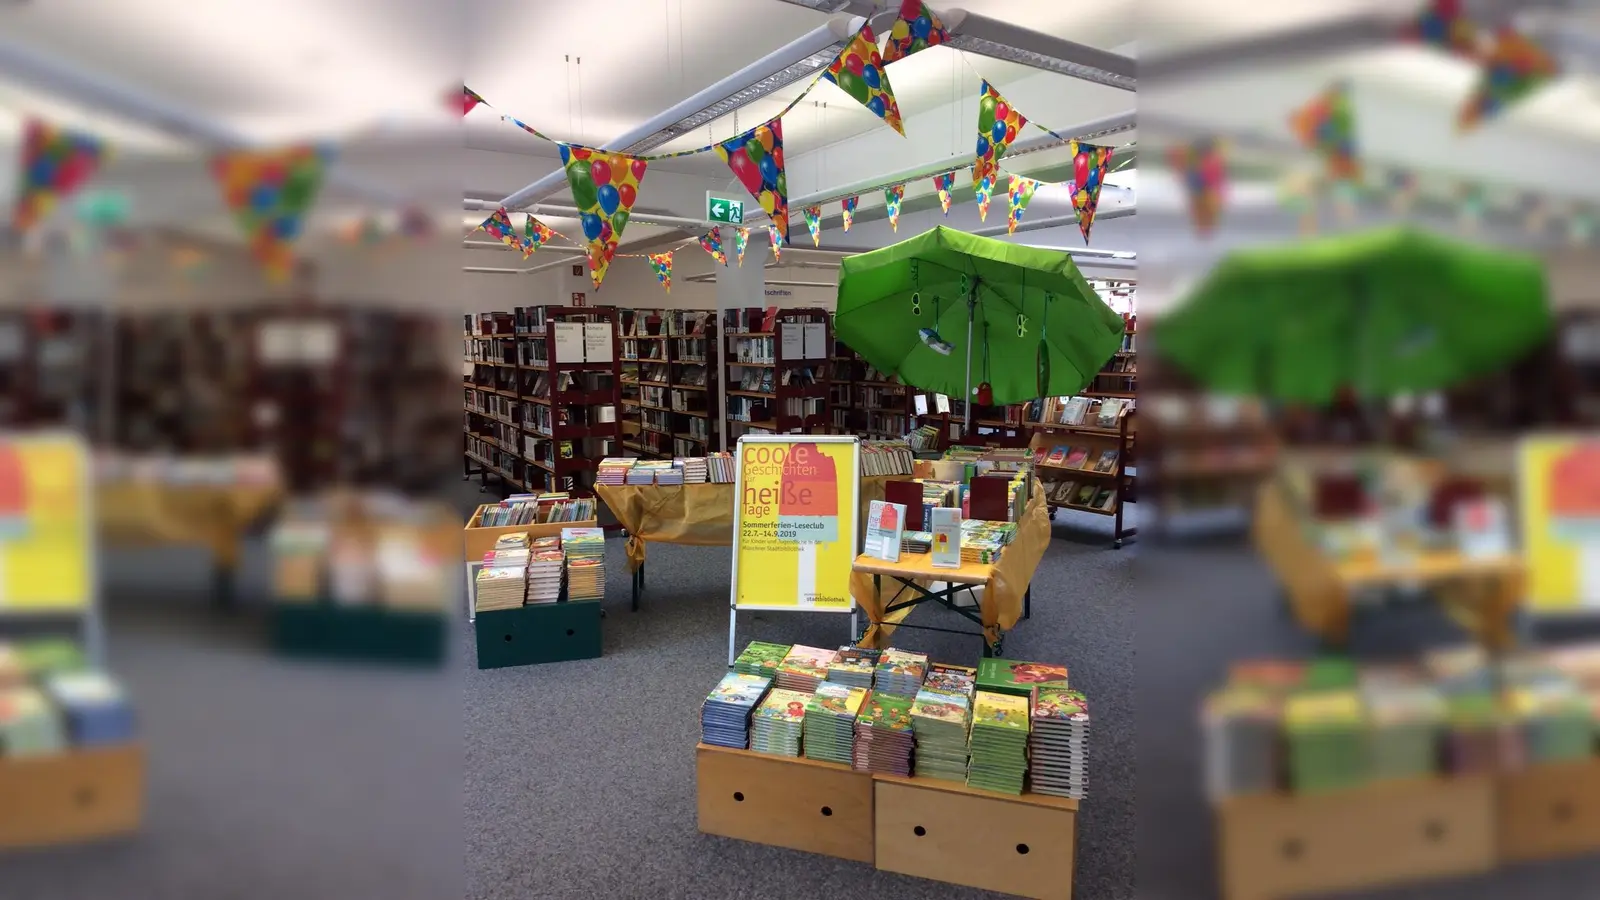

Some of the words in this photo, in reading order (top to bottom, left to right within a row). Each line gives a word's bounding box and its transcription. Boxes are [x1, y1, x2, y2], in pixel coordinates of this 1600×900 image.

[743, 442, 809, 465] coole
[743, 463, 817, 476] Geschichten
[743, 480, 813, 506] heiße
[742, 502, 771, 519] Tage
[742, 521, 825, 530] Sommerferien-Leseclub
